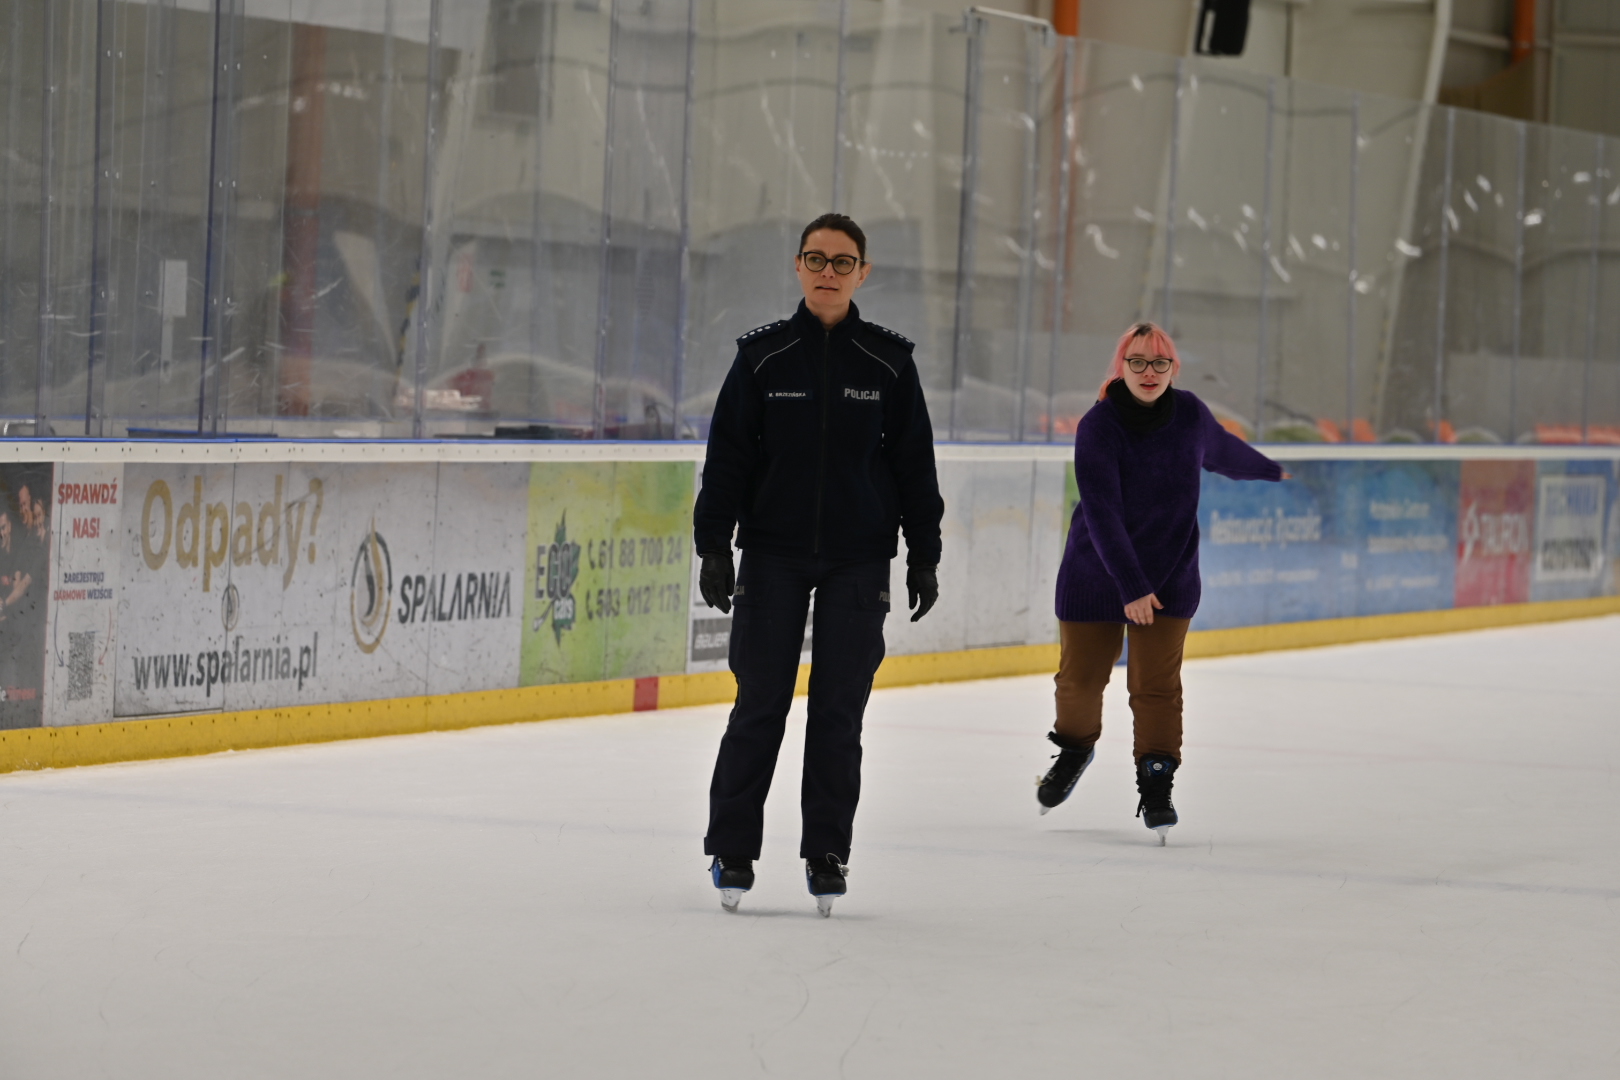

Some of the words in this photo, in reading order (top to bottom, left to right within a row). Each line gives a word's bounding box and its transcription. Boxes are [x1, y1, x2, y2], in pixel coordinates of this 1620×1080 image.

[844, 388, 880, 401] POLICJA
[58, 478, 117, 505] SPRAWDŹ
[72, 517, 100, 539] NAS!
[141, 474, 324, 593] Odpady?
[598, 538, 614, 569] 61
[619, 538, 635, 567] 88
[640, 537, 664, 566] 700
[666, 536, 682, 564] 24
[398, 571, 512, 625] SPALARNIA
[133, 631, 318, 698] www.spalarnia.pl
